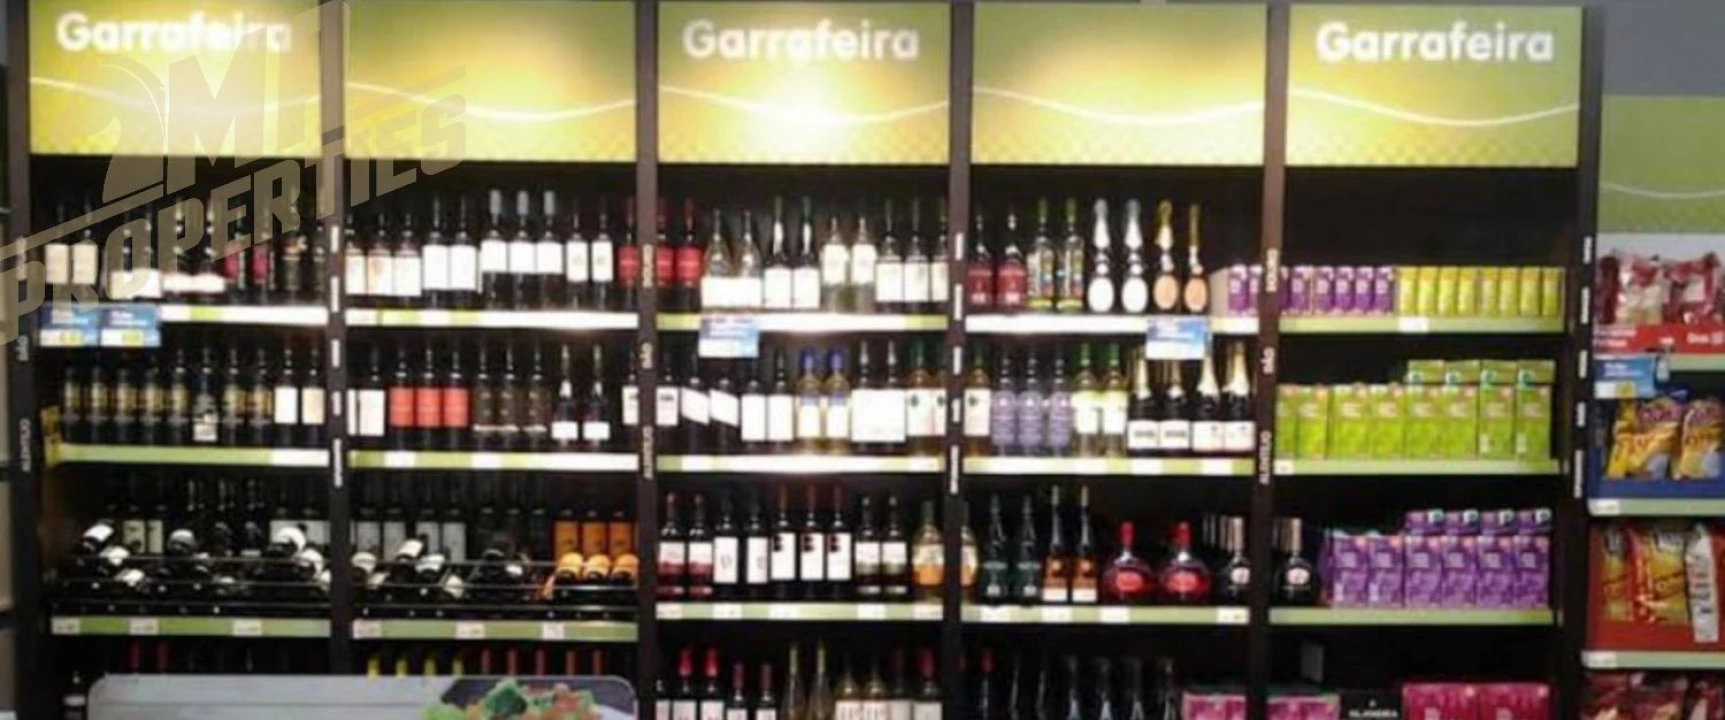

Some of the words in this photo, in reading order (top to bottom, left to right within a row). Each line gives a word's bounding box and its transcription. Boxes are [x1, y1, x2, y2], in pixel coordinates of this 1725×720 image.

[56, 10, 292, 53] Garrafeira
[683, 18, 919, 61] Garrafeira
[1317, 21, 1554, 61] Garrafeira
